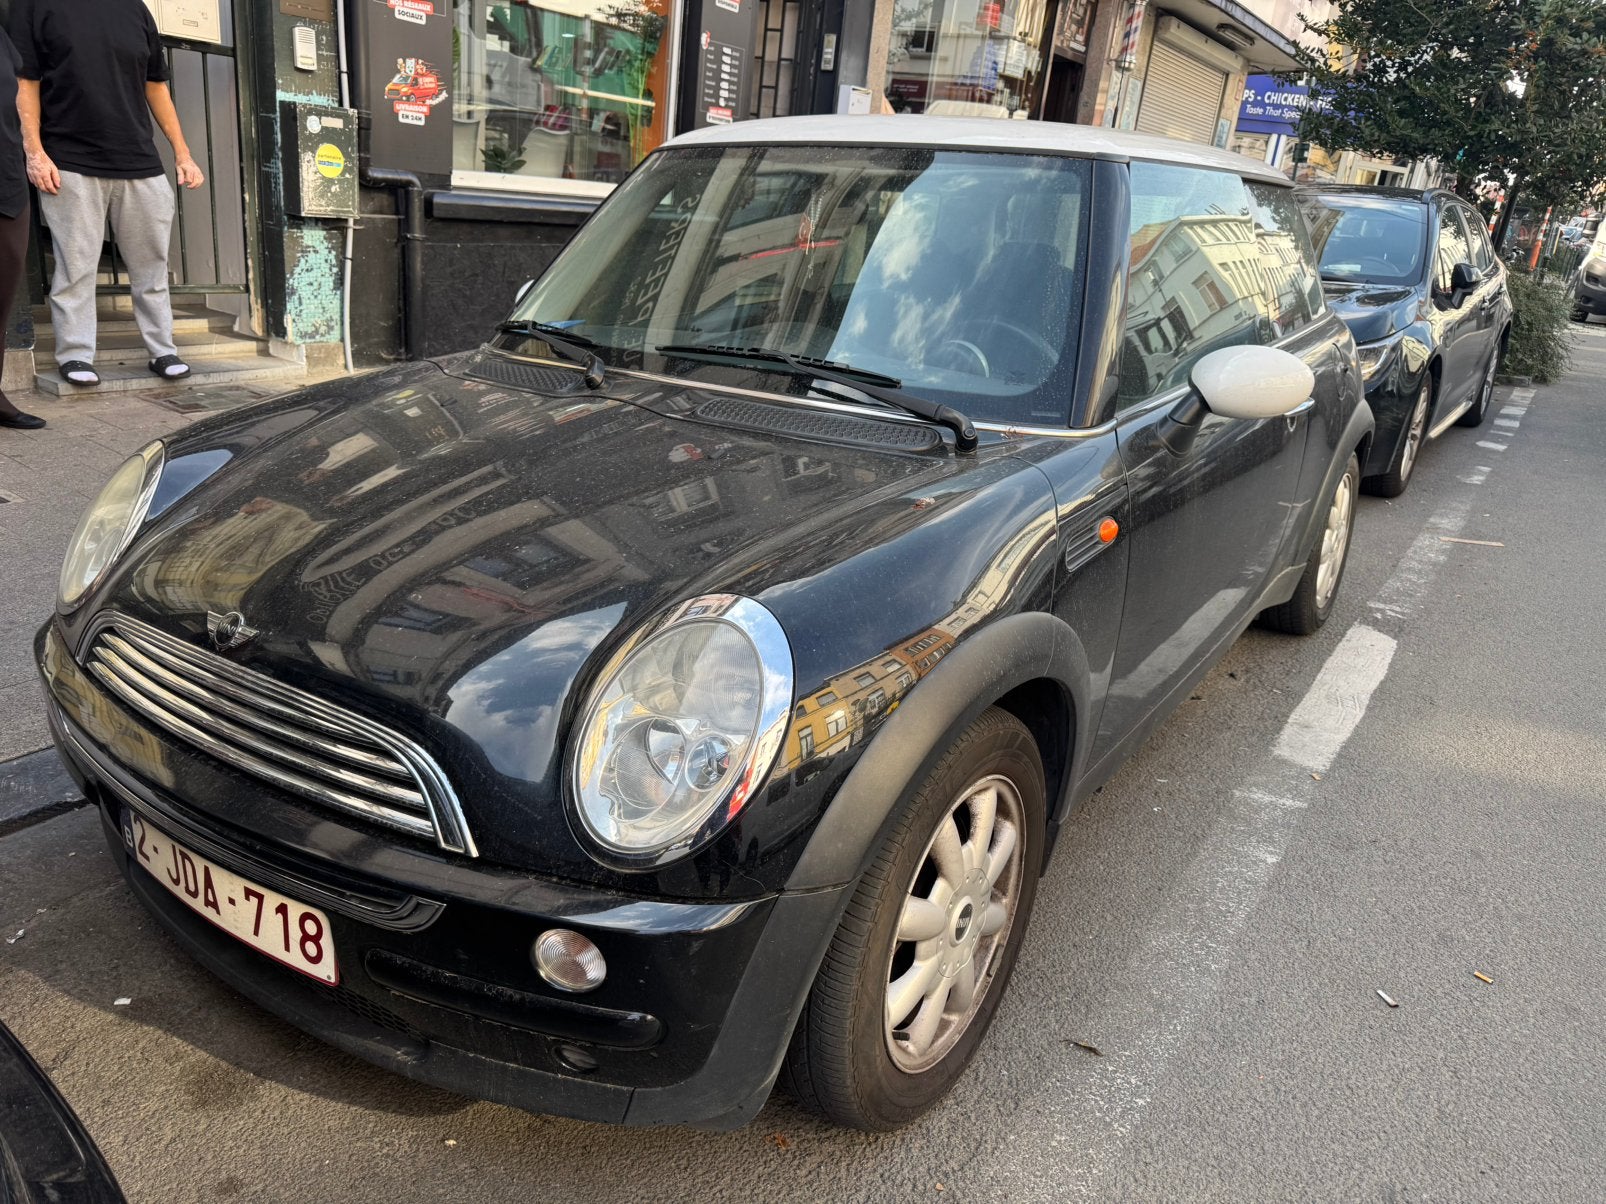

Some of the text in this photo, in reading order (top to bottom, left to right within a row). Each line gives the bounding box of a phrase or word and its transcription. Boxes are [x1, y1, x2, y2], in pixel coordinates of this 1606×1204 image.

[397, 9, 424, 21] SOCIAUX
[395, 103, 428, 113] LIVRAISON
[1264, 91, 1308, 107] CHICKEN
[1316, 96, 1336, 110] FIS
[1245, 104, 1302, 120] Taste That Spec
[124, 825, 134, 848] B
